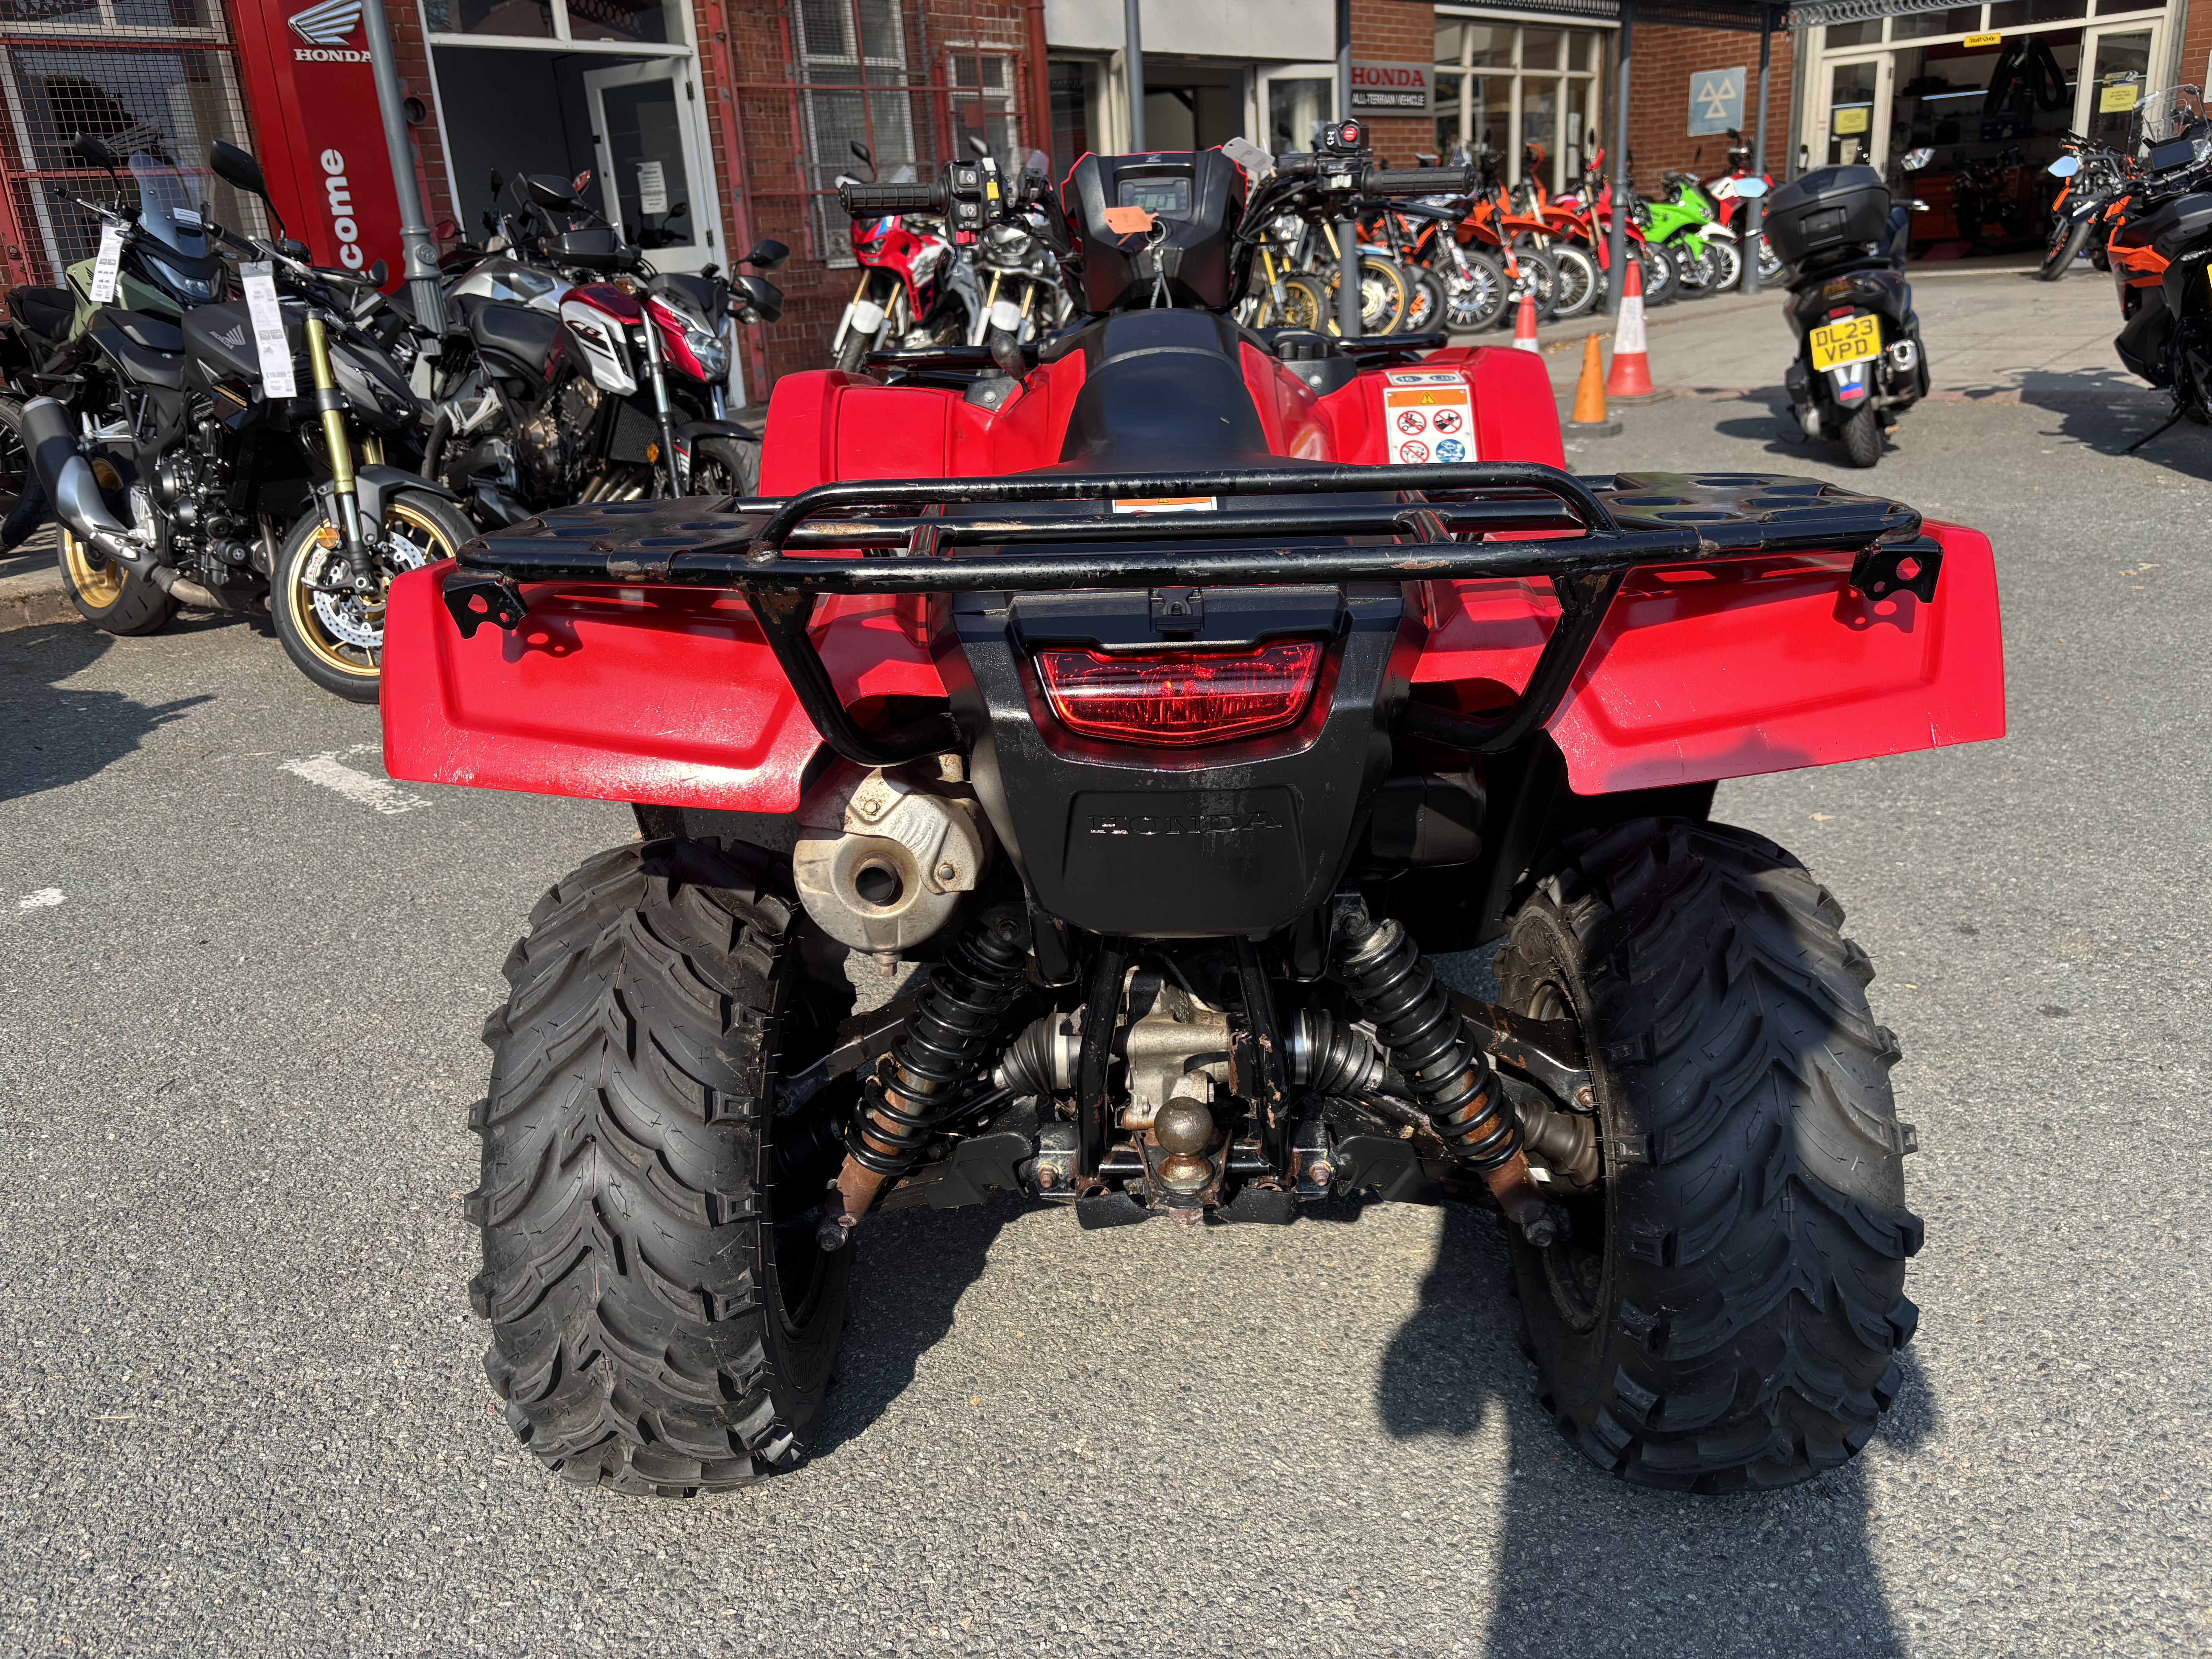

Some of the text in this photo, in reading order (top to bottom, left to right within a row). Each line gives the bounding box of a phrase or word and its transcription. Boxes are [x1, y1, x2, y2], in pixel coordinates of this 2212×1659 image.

[294, 49, 373, 63] HONDA
[1351, 67, 1426, 87] HONDA
[320, 148, 367, 280] come
[1816, 319, 1873, 347] DL23
[1825, 339, 1868, 361] VPD
[1087, 811, 1282, 835] HONDA
